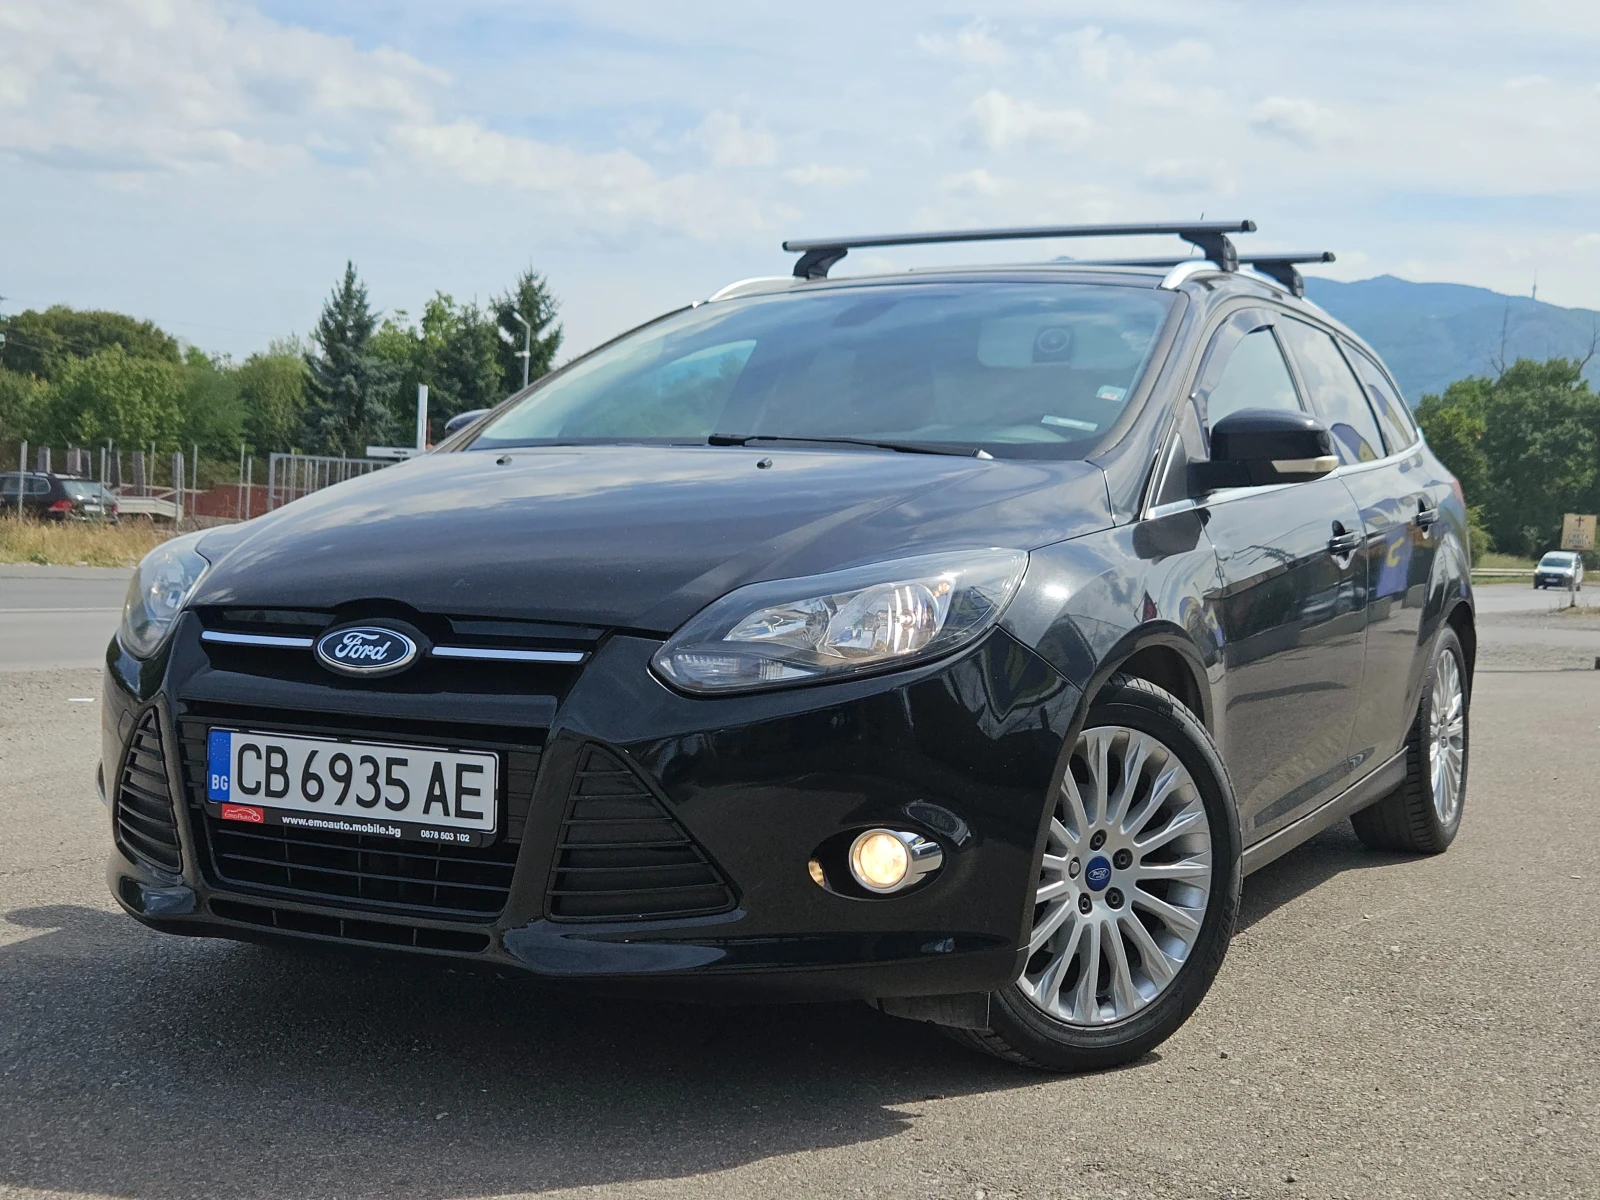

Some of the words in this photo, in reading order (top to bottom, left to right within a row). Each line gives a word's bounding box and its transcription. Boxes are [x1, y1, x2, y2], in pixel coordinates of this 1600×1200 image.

[334, 632, 392, 660] Ford
[212, 774, 229, 791] BG
[237, 743, 290, 798] CB
[301, 750, 411, 811] 6935
[422, 761, 484, 819] AE
[281, 815, 402, 838] www.emoauto.mobile.bg
[420, 829, 439, 840] 0878
[440, 832, 455, 841] 503
[457, 834, 470, 843] 102
